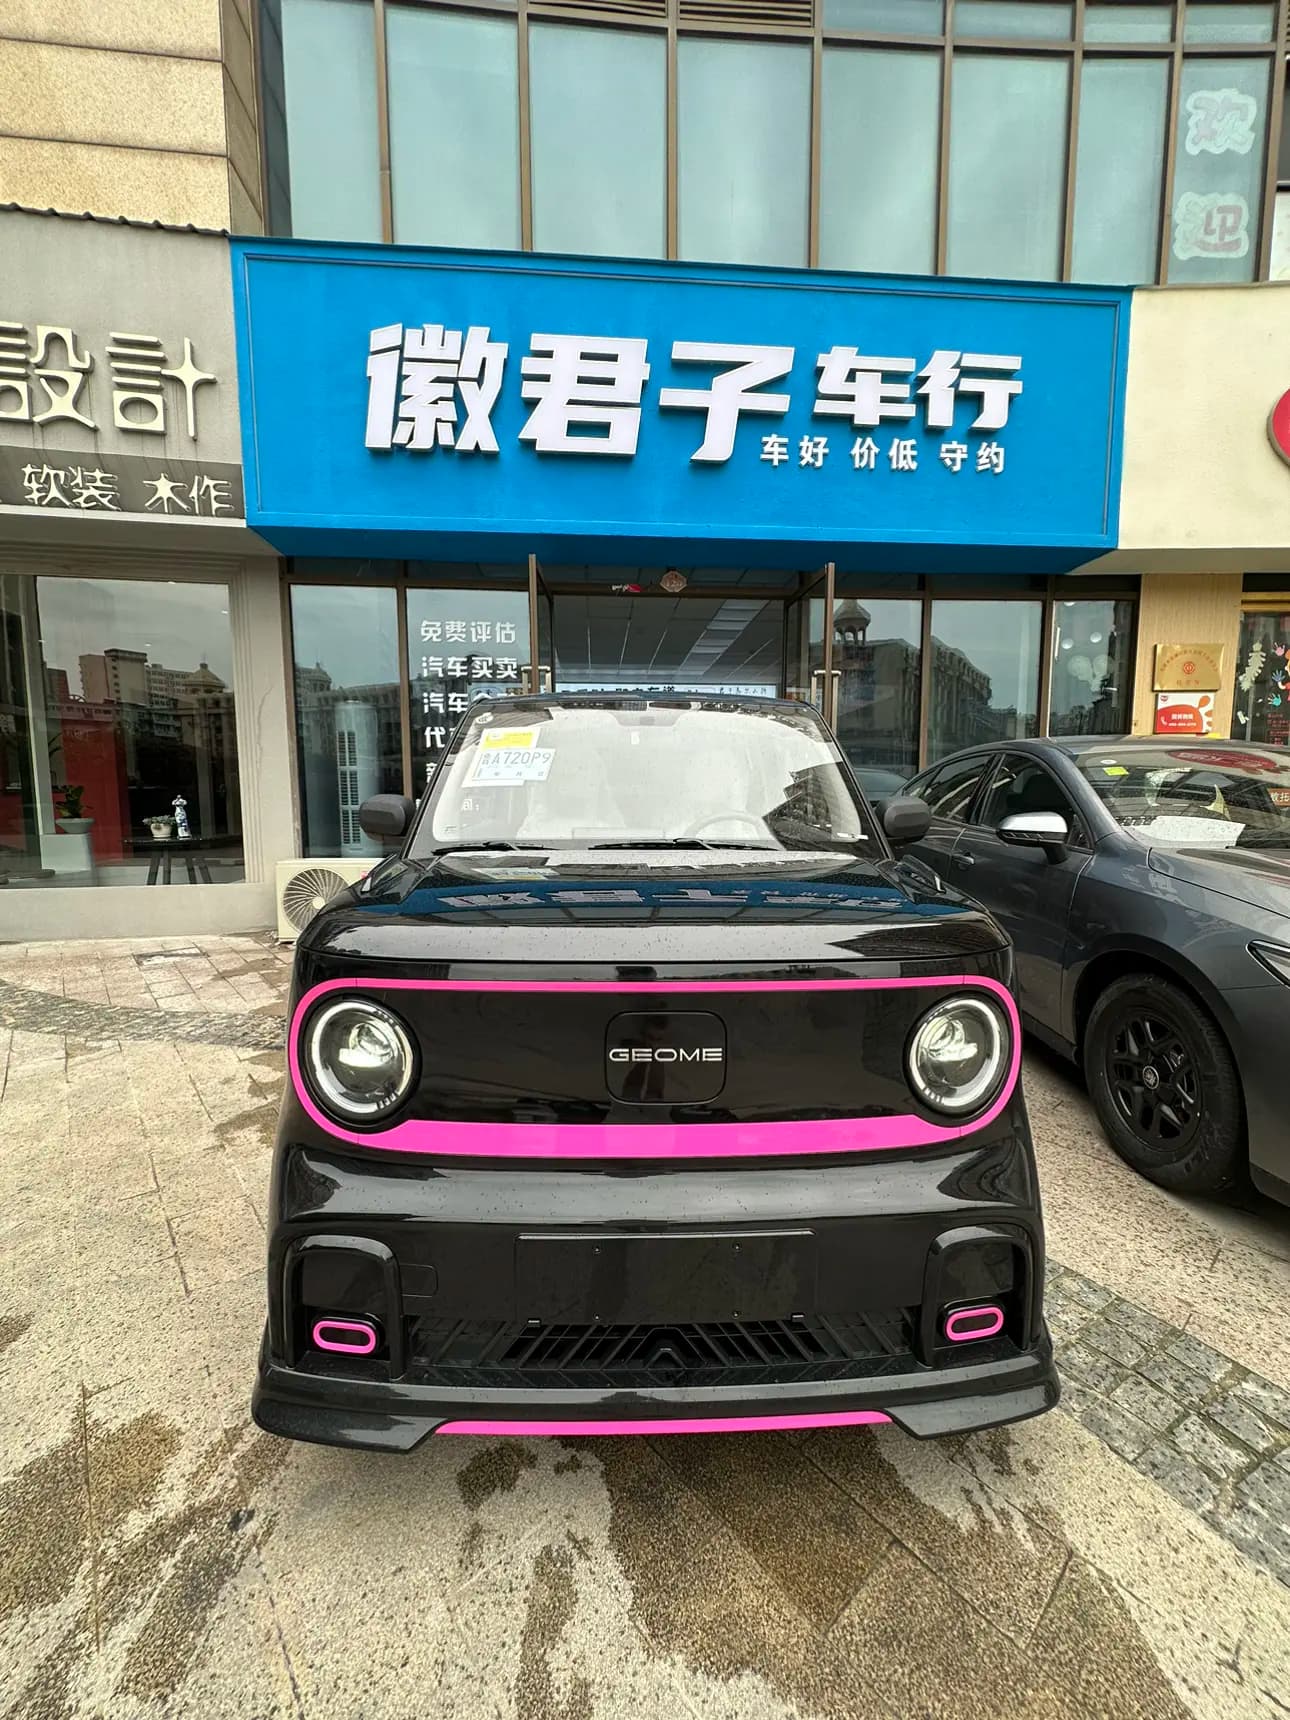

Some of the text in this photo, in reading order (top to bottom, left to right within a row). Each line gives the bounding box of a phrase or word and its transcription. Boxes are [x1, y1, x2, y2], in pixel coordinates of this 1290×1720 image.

[365, 323, 1023, 464] 徽君子车行
[760, 433, 1006, 475] 车好 价低 守约
[21, 463, 235, 517] 软装 木作
[420, 620, 516, 644] 免费评估
[422, 656, 518, 680] 汽车买卖
[608, 1047, 723, 1062] GEOME
